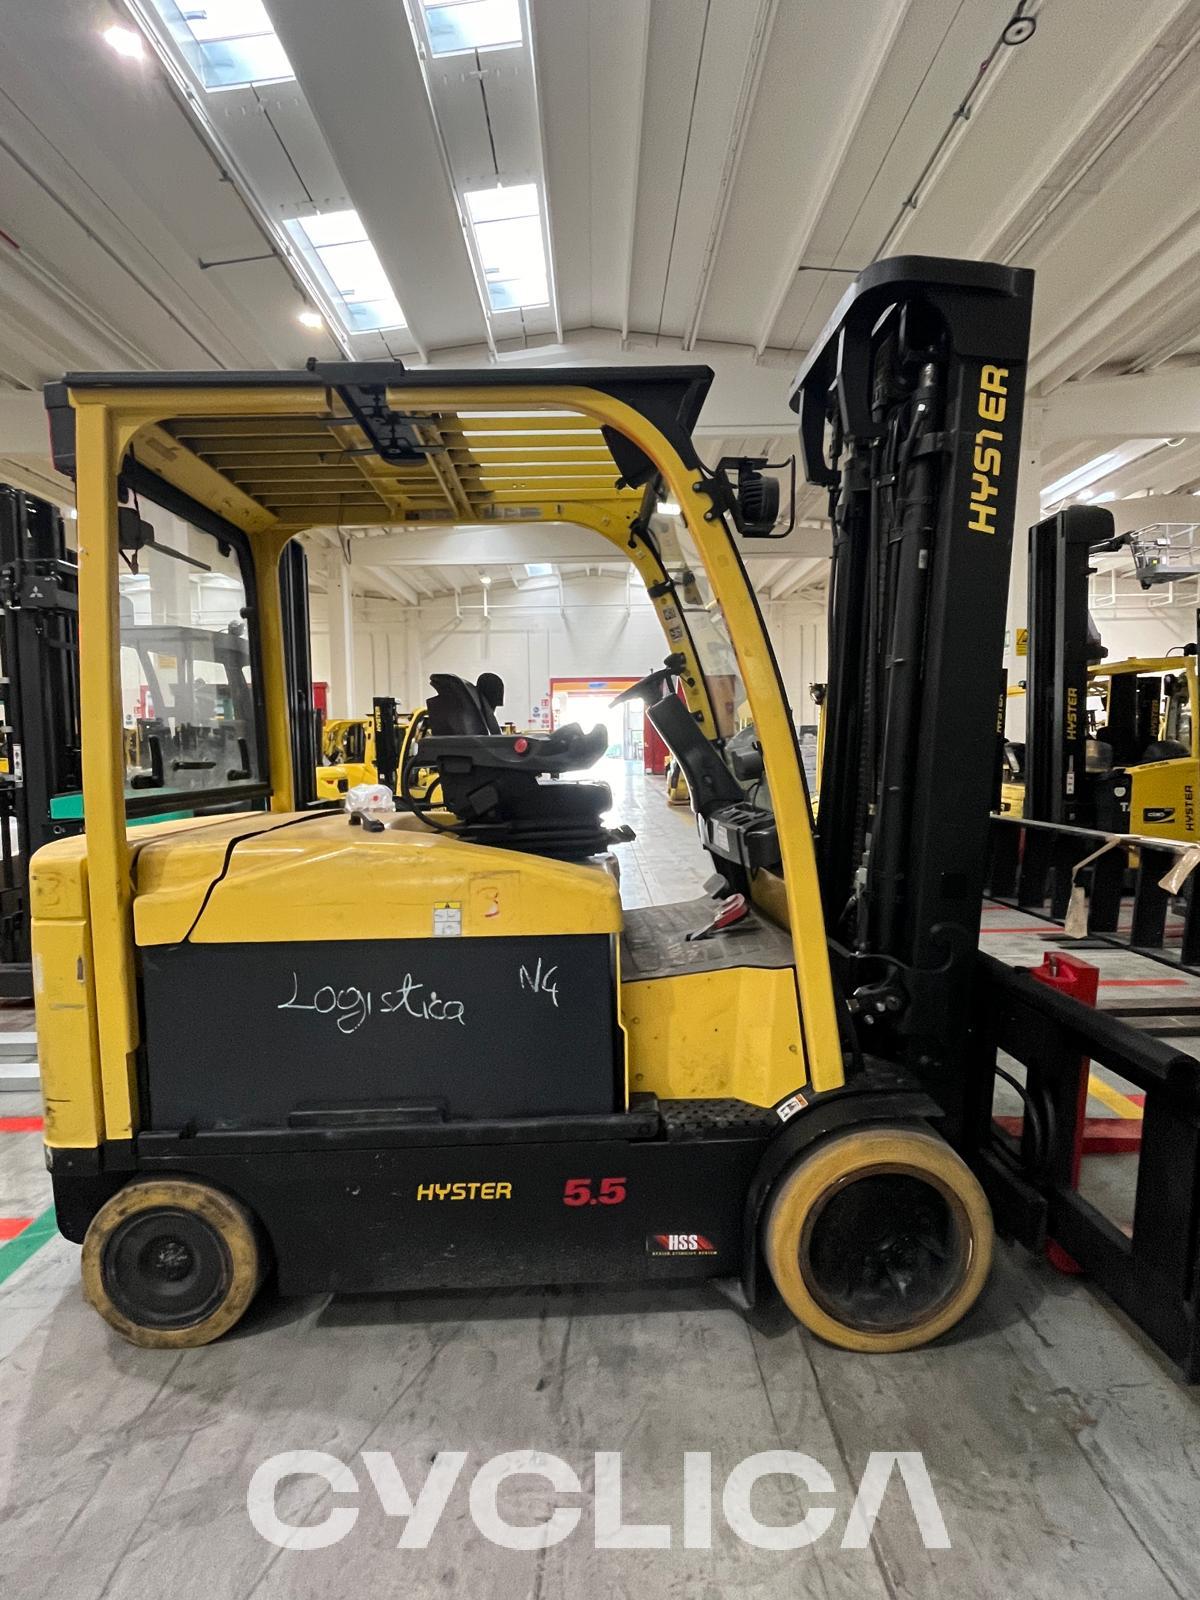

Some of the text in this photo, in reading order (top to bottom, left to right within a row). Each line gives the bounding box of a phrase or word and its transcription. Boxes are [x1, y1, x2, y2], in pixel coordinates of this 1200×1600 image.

[968, 364, 1009, 535] HYSTER
[1066, 687, 1078, 740] HYSTER
[1184, 785, 1194, 831] HYSTER
[277, 972, 466, 1034] Logistica
[416, 1182, 512, 1201] HYSTER
[562, 1177, 627, 1206] 5.5
[668, 1234, 698, 1251] HSS
